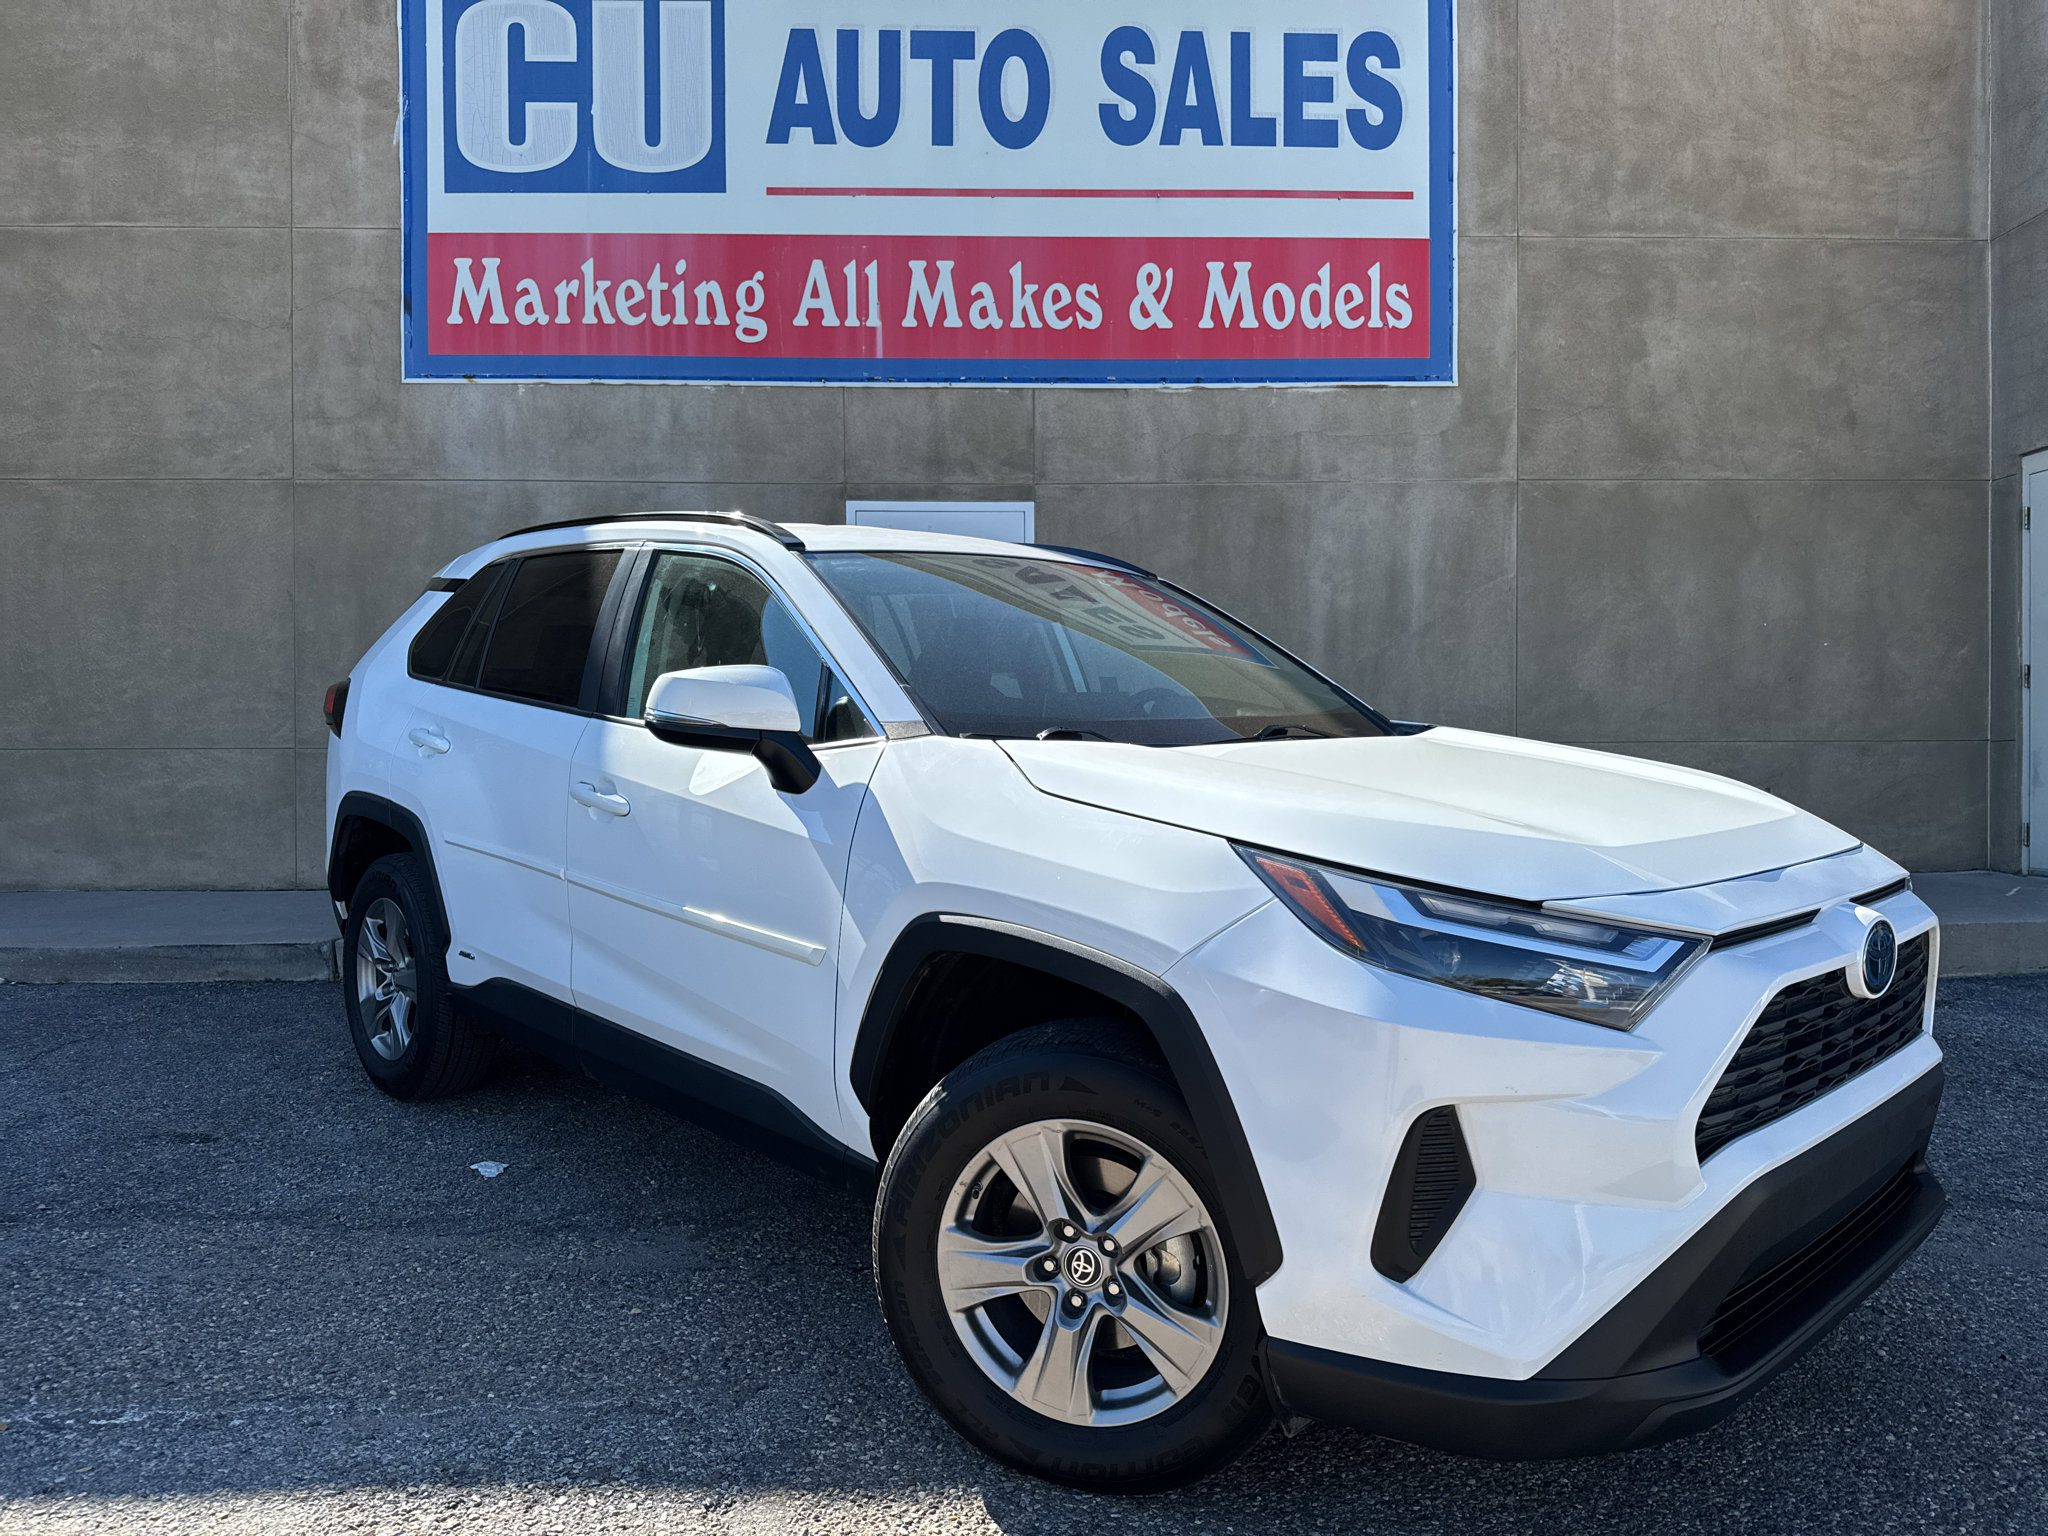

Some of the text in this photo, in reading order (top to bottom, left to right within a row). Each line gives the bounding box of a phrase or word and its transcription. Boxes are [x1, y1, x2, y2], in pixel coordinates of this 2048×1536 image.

[455, 0, 713, 174] CU
[765, 26, 1403, 151] AUTO SALES
[446, 257, 1413, 343] Marketing All Makes & Models
[888, 1072, 1050, 1226] ARIZONIAN
